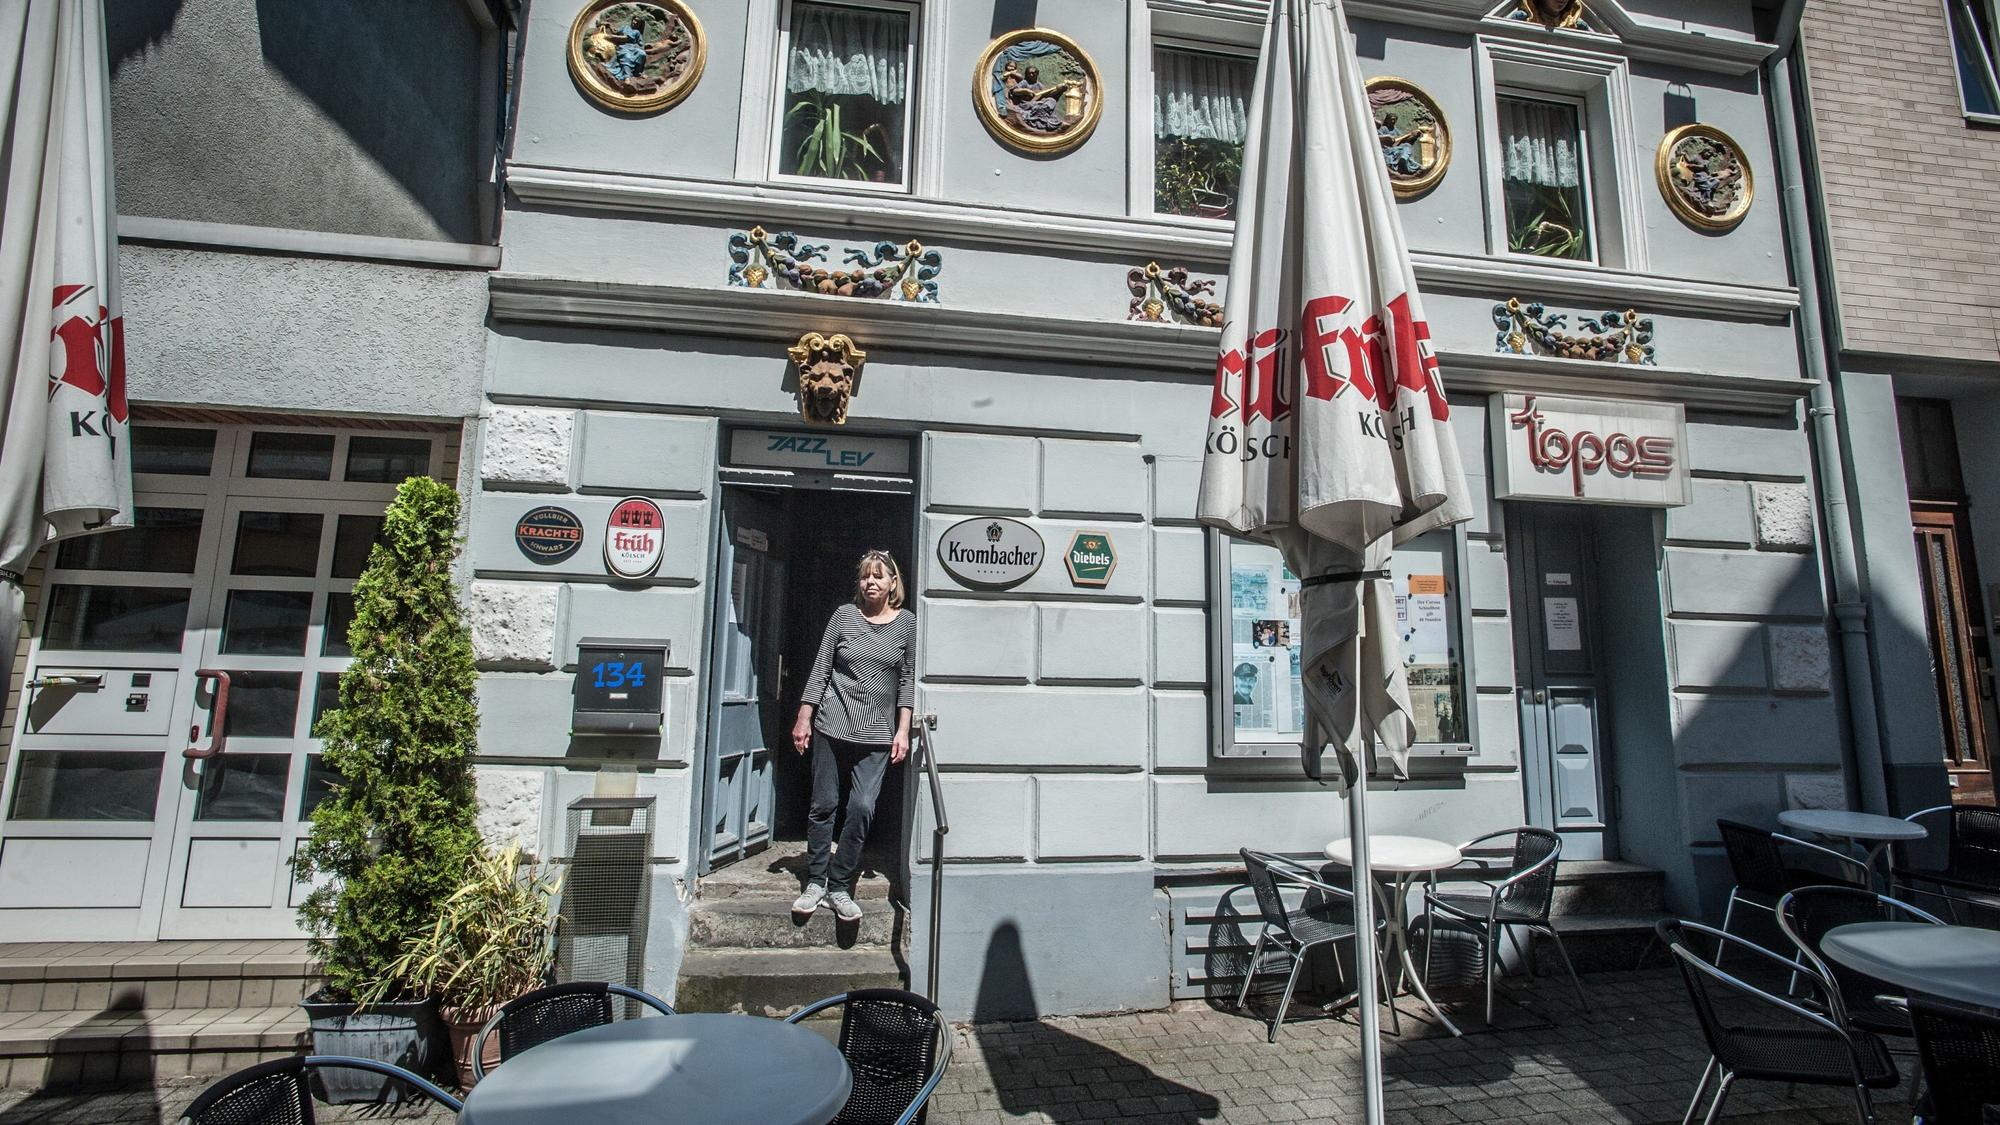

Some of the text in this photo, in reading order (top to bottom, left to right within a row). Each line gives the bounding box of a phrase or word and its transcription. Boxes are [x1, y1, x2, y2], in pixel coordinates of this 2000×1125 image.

[767, 435, 828, 453] JAZZ
[1511, 396, 1676, 497] topos
[826, 451, 875, 467] LEV
[532, 512, 569, 524] VOLLBIER
[519, 525, 579, 540] KRACHTS
[948, 541, 1038, 566] Krombacher
[1072, 550, 1111, 565] Diebels
[591, 662, 647, 688] 134
